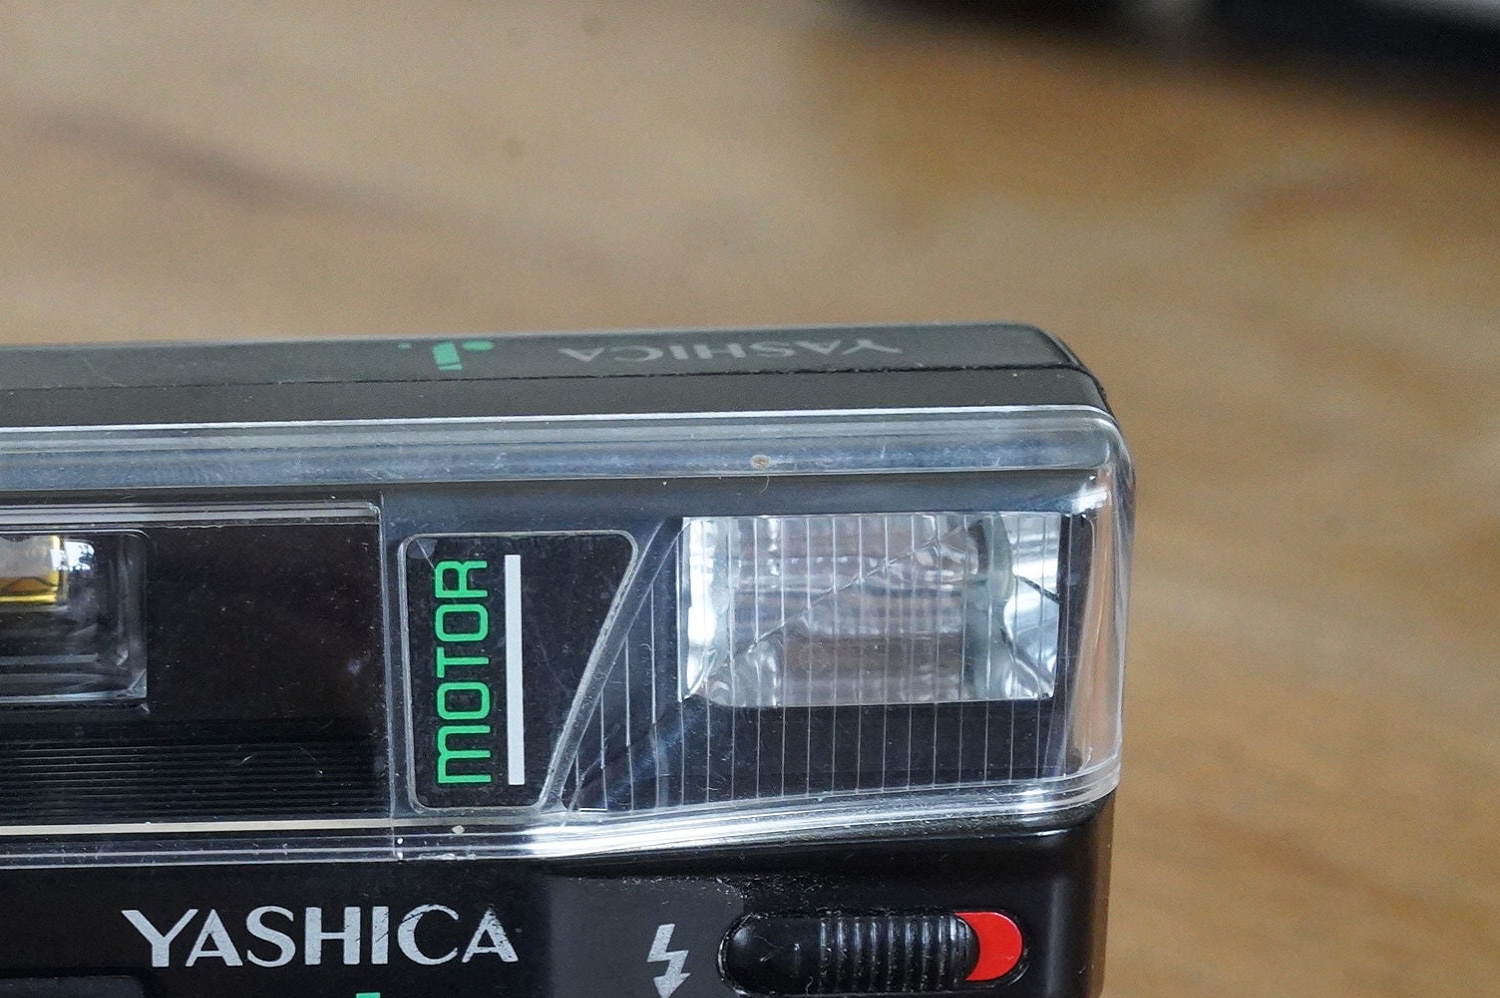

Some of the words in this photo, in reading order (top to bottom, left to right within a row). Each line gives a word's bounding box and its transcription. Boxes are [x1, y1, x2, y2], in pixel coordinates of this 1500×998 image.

[557, 338, 902, 363] YASHICA
[435, 560, 492, 783] MOTOR
[121, 904, 519, 967] YASHICA
